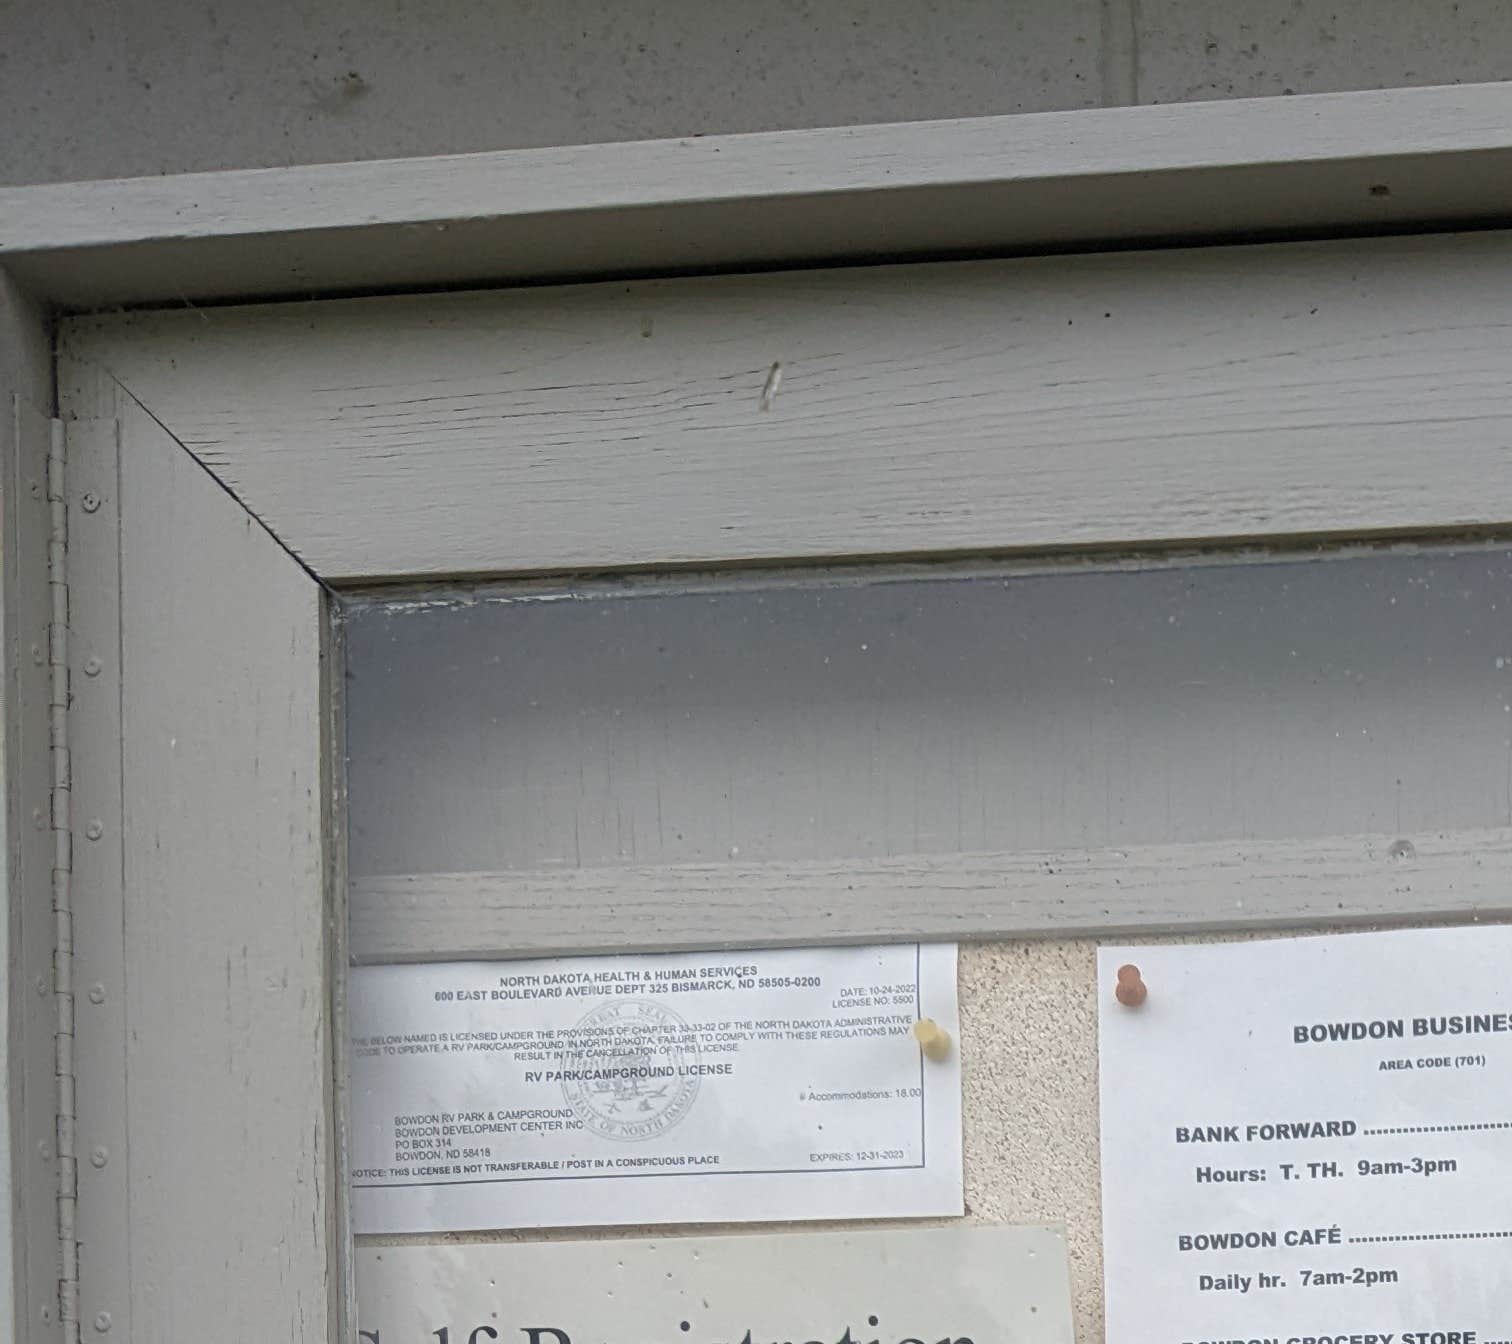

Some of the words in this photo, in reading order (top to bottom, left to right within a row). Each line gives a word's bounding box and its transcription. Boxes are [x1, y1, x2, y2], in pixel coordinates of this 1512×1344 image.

[499, 975, 540, 987] NORTH
[541, 971, 592, 986] DAKOTA
[593, 970, 640, 983] HEALTH
[643, 970, 651, 981] &
[654, 968, 696, 980] HUMAN
[699, 965, 757, 979] SERVICES
[456, 990, 487, 1001] EAST
[490, 985, 562, 1000] BOULEVARD
[614, 983, 646, 994] DEPT
[648, 982, 668, 994] 325
[738, 978, 755, 989] ND
[758, 976, 820, 988] 58505-0200
[839, 987, 868, 998] DATE:
[868, 984, 917, 995] 10-24-2022
[831, 998, 873, 1009] LICENSE
[873, 997, 891, 1007] NO:
[1293, 1018, 1403, 1044] BOWDON
[1378, 1058, 1413, 1071] AREA
[1416, 1056, 1451, 1068] CODE
[1454, 1055, 1485, 1069] (701)
[525, 1071, 542, 1082] RV
[545, 1064, 675, 1082] PARK/CAMPGROUND
[677, 1063, 732, 1077] LICENSE
[394, 1114, 439, 1126] BOWDON
[441, 1113, 455, 1124] RV
[457, 1111, 485, 1122] PARK
[487, 1111, 494, 1121] &
[496, 1108, 575, 1120] CAMPGROUND
[395, 1139, 409, 1150] PO
[411, 1138, 433, 1150] BOX
[435, 1137, 451, 1148] 314
[809, 1152, 853, 1162] EXPIRES:
[856, 1149, 904, 1161] 12-31-2023
[1196, 1166, 1266, 1183] Hours:
[1279, 1163, 1299, 1180] T.
[1306, 1161, 1343, 1179] TH.
[1357, 1157, 1457, 1177] 9am-3pm
[1199, 1273, 1251, 1293] Daily
[1258, 1272, 1286, 1288] hr.
[1299, 1267, 1398, 1287] 7am-2pm
